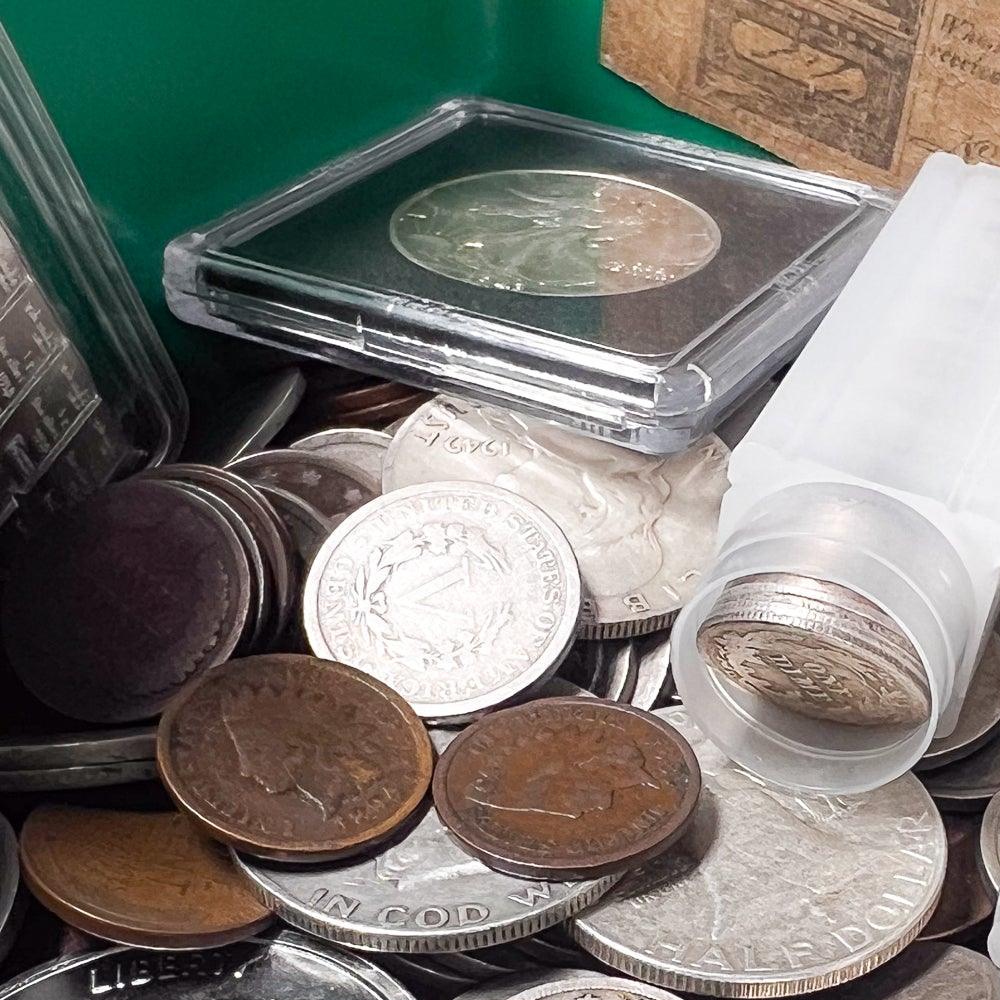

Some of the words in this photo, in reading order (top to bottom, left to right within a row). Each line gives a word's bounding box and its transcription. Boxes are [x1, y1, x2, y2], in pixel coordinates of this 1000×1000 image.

[302, 887, 362, 921] IN
[643, 940, 815, 973] HALF
[829, 811, 935, 952] DOLLAR
